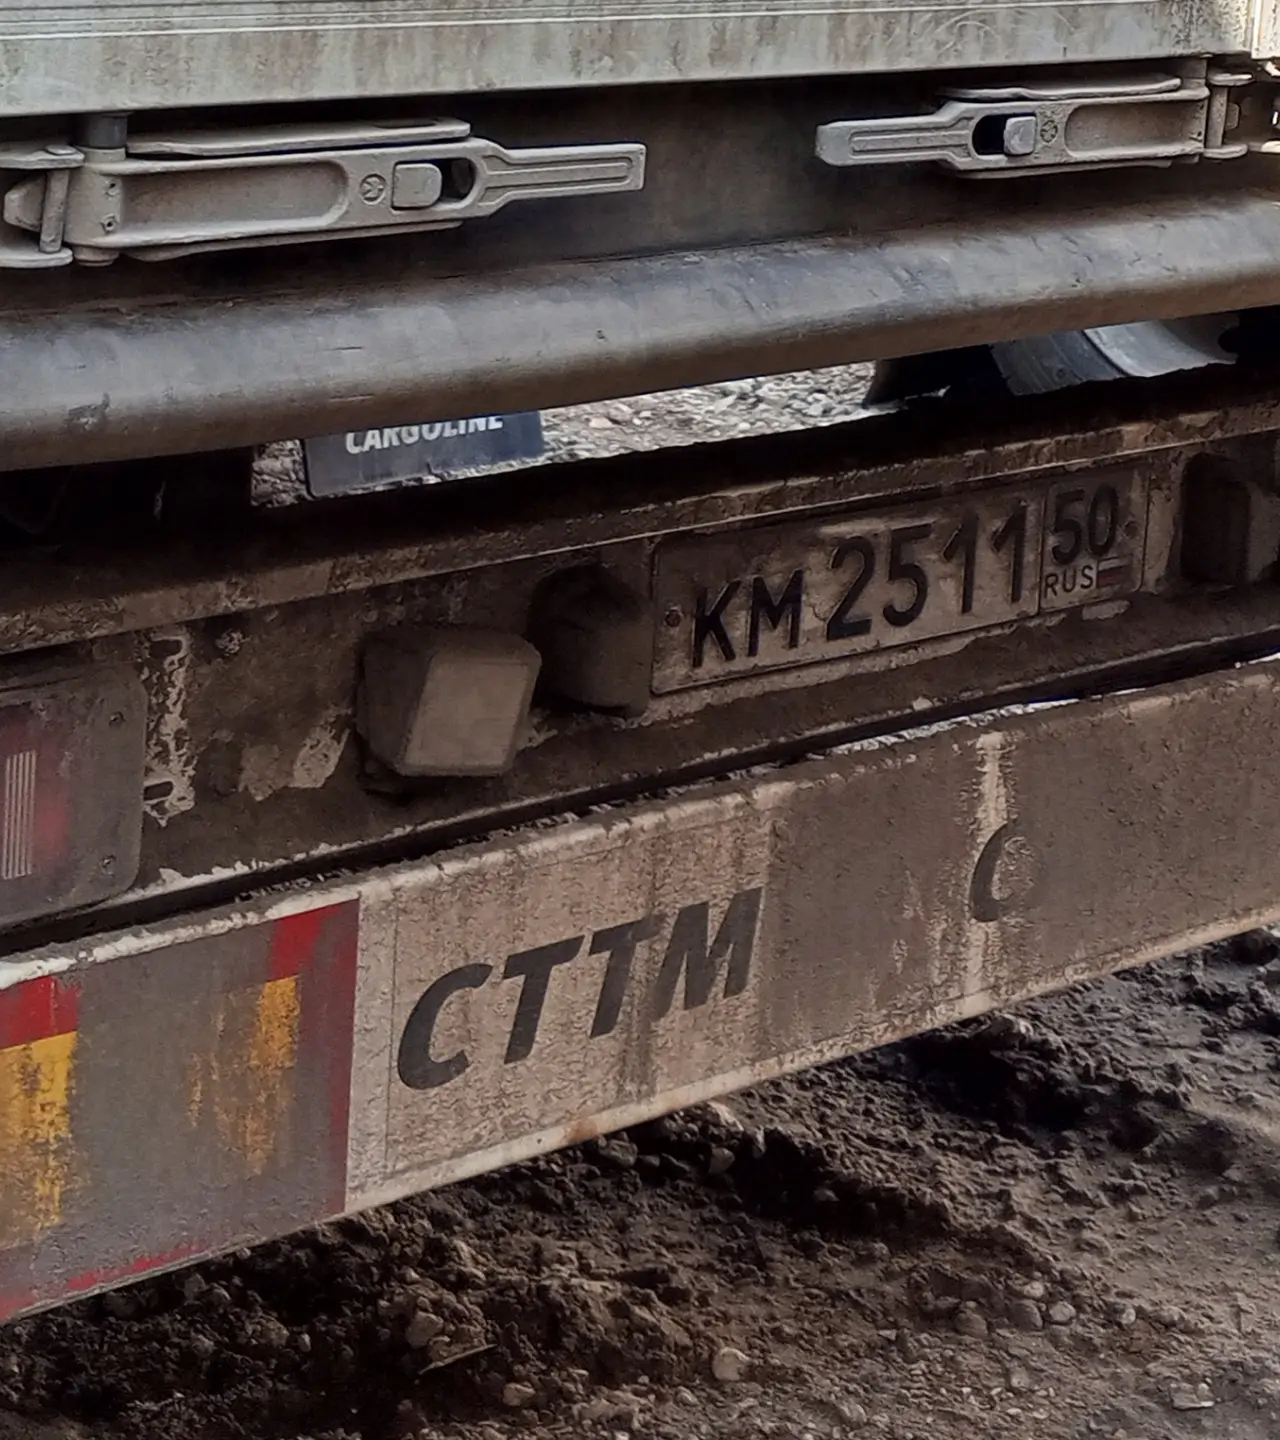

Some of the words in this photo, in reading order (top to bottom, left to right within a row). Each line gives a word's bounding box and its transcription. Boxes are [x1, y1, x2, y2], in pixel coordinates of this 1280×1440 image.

[1051, 484, 1119, 564] 50
[1043, 564, 1096, 597] RUS
[397, 887, 763, 1089] CTTM
